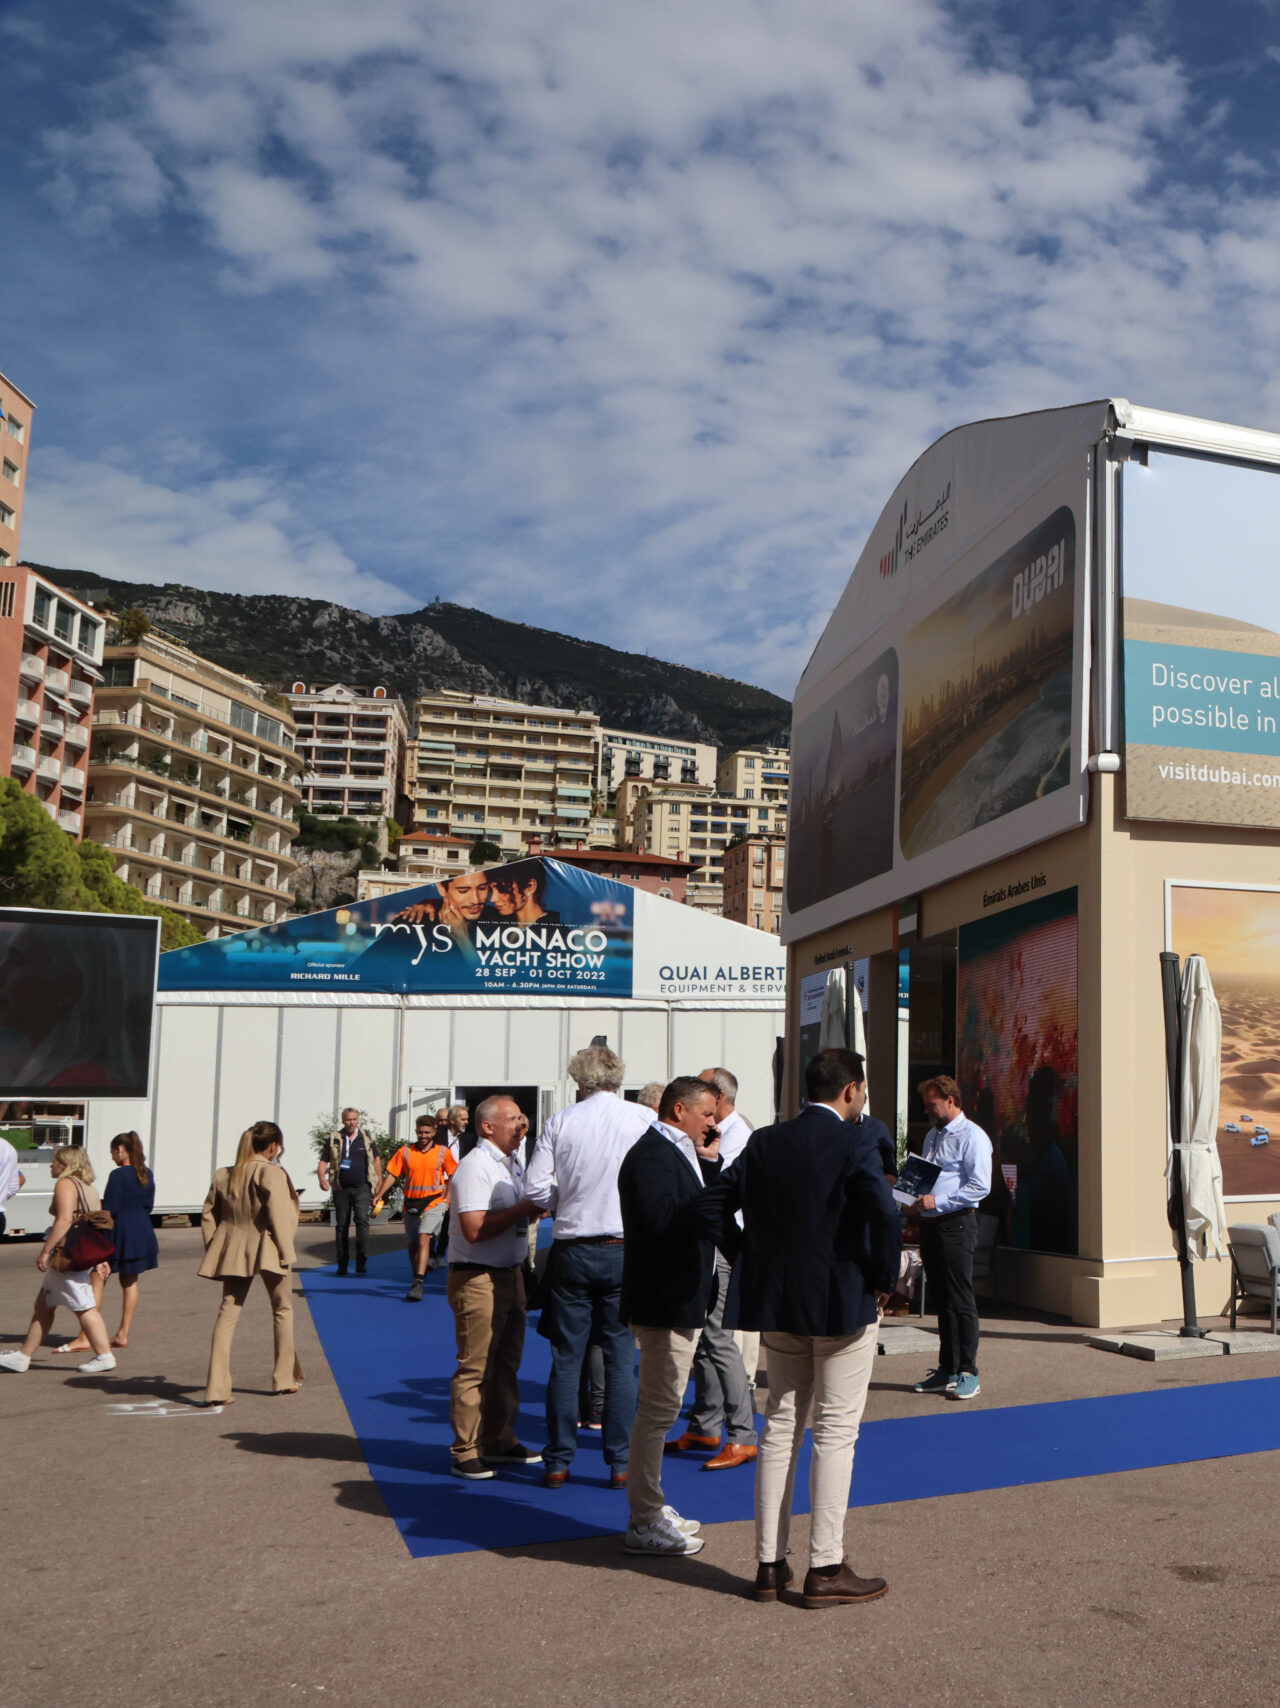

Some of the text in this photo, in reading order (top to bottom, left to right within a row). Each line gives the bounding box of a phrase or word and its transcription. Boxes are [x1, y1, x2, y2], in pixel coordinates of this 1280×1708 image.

[1012, 538, 1065, 620] DUBAI
[1151, 663, 1253, 695] Discover
[1152, 703, 1249, 730] possible
[1257, 709, 1276, 734] in
[1007, 880, 1031, 899] Arabes
[1031, 872, 1047, 890] Unis
[370, 923, 453, 966] mys
[476, 926, 608, 952] MONACO
[476, 950, 605, 969] YACHT SHOW
[475, 968, 490, 977] 28
[495, 968, 517, 977] SEP
[529, 969, 543, 978] 01
[547, 969, 572, 979] OCT
[576, 971, 606, 980] 2022
[659, 965, 786, 981] QUAI ALBERT
[660, 983, 734, 993] EQUIPMENT
[738, 984, 747, 993] &
